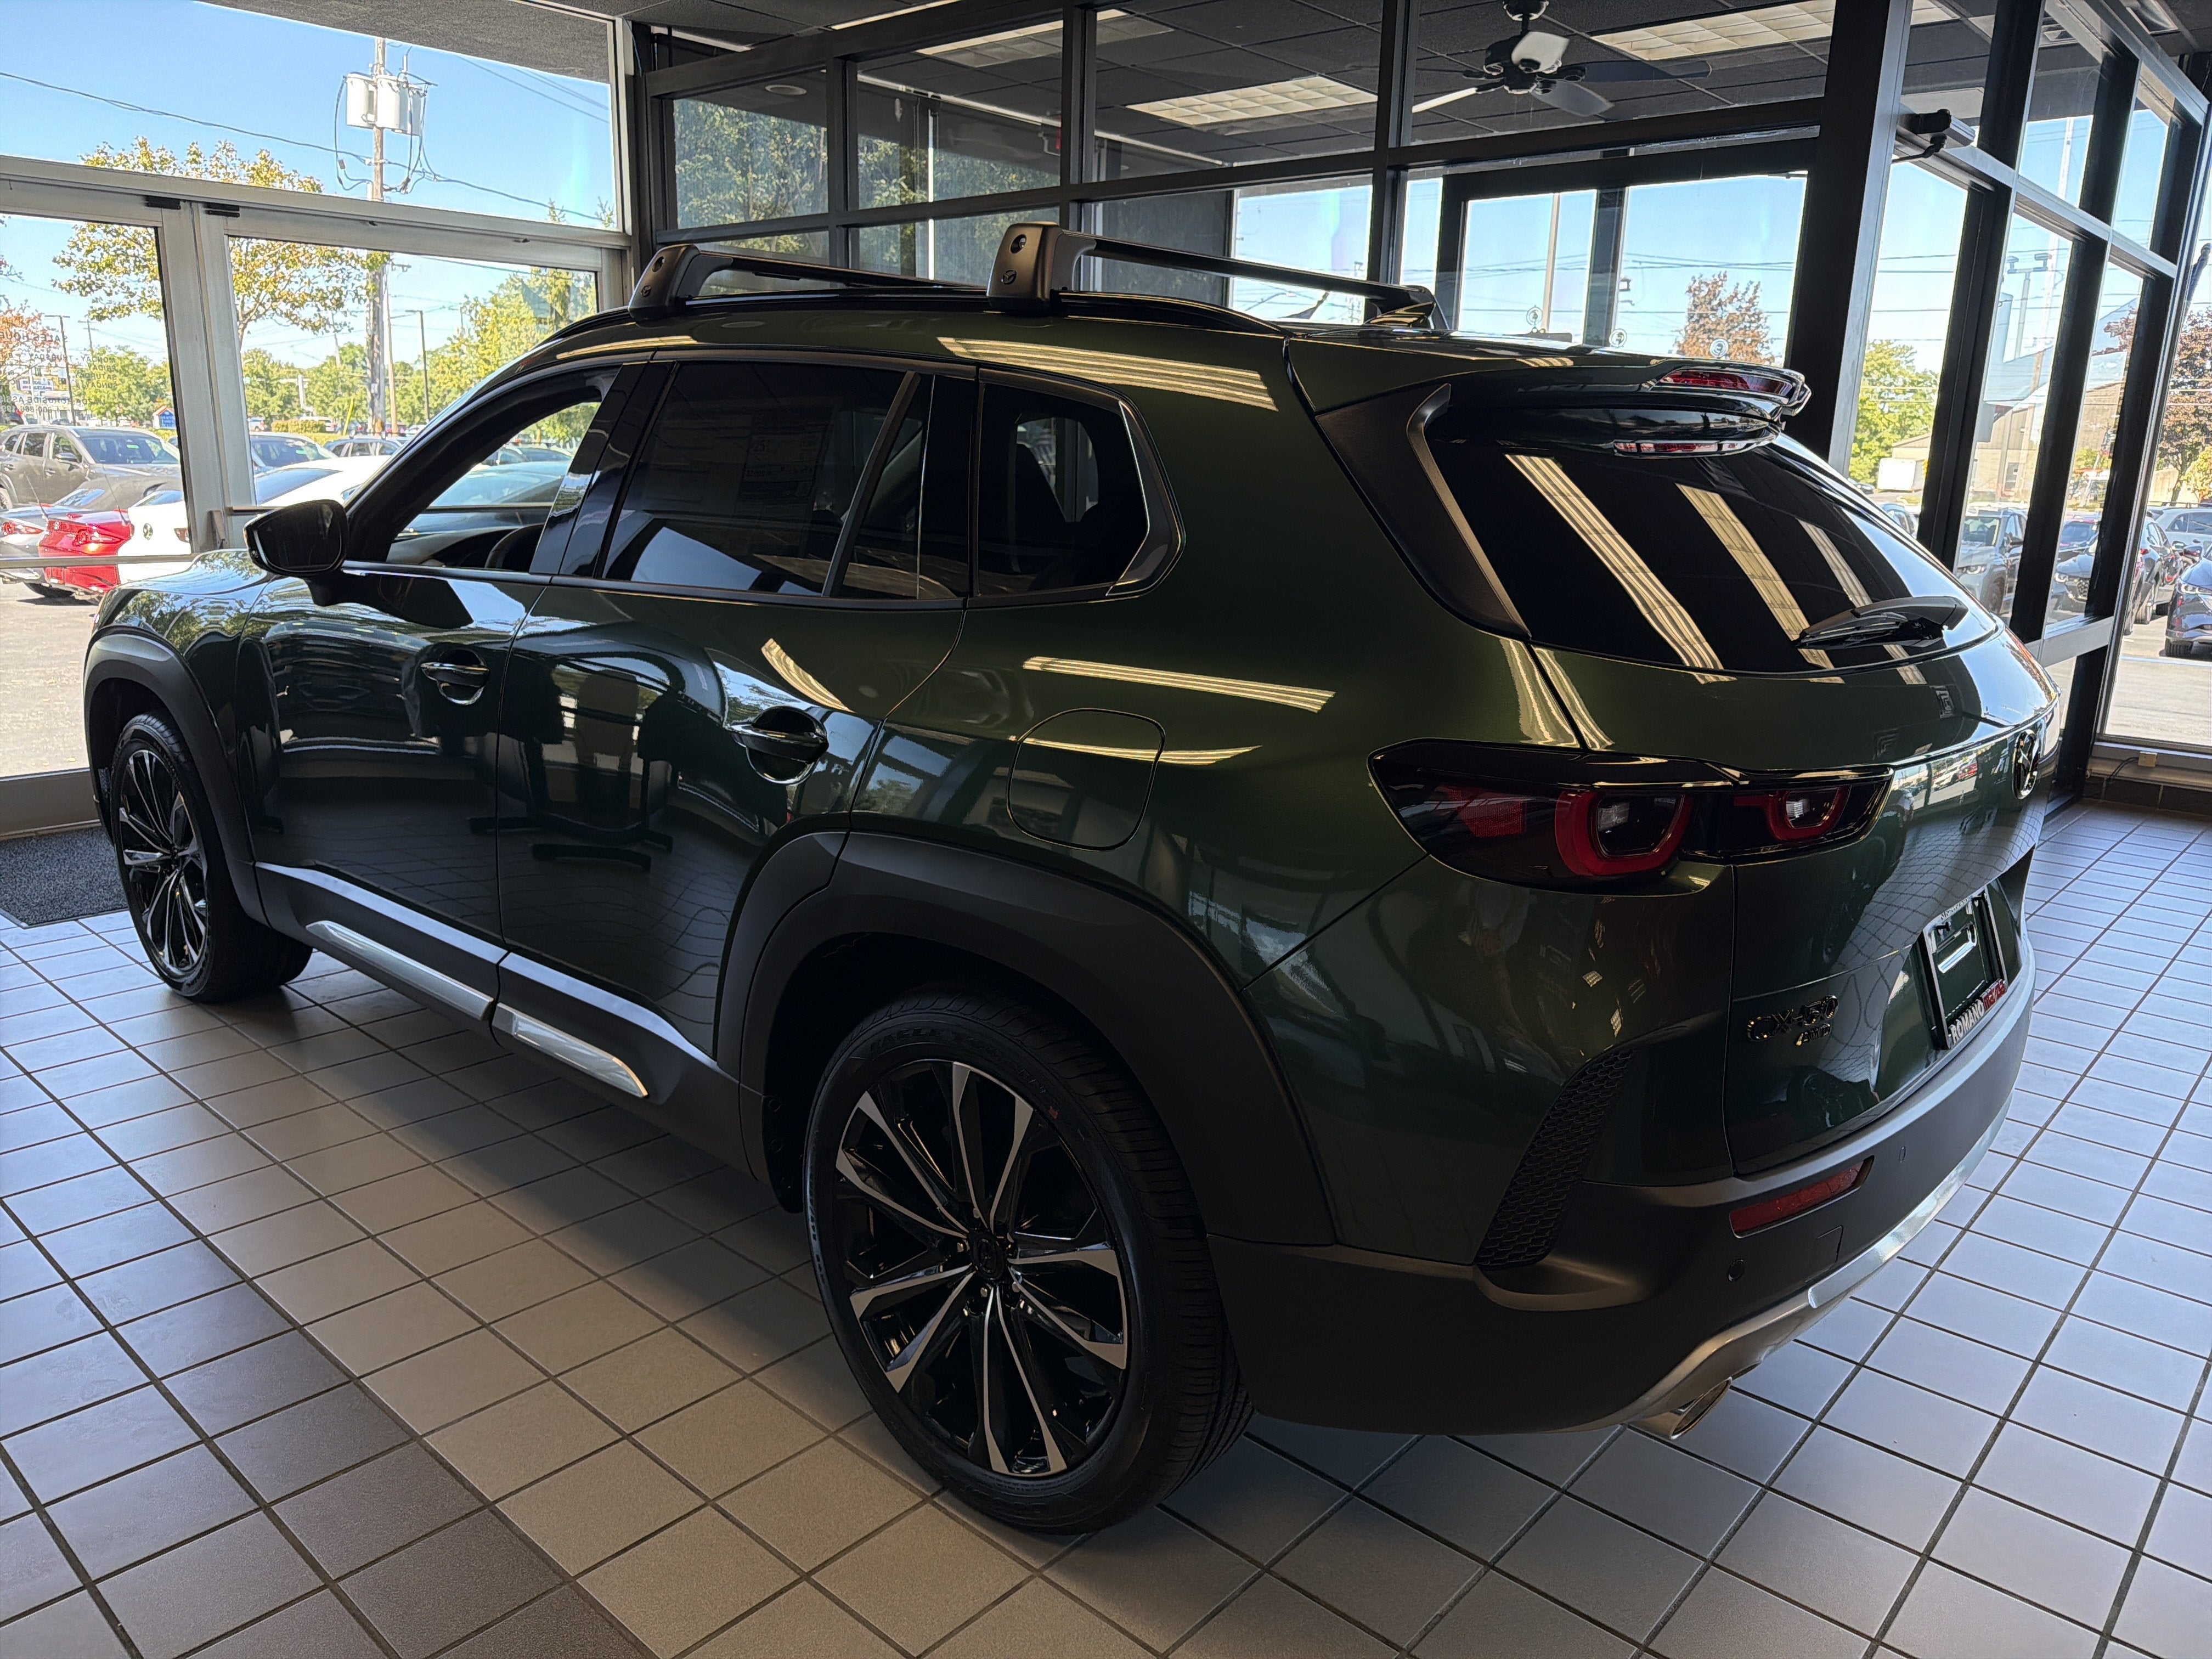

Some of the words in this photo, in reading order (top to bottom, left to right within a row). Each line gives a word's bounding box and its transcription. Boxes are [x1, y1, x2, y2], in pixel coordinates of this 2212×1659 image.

[1747, 994, 1839, 1042] CX-50
[1796, 1023, 1832, 1047] AWD
[1949, 1000, 1985, 1045] ROMANO
